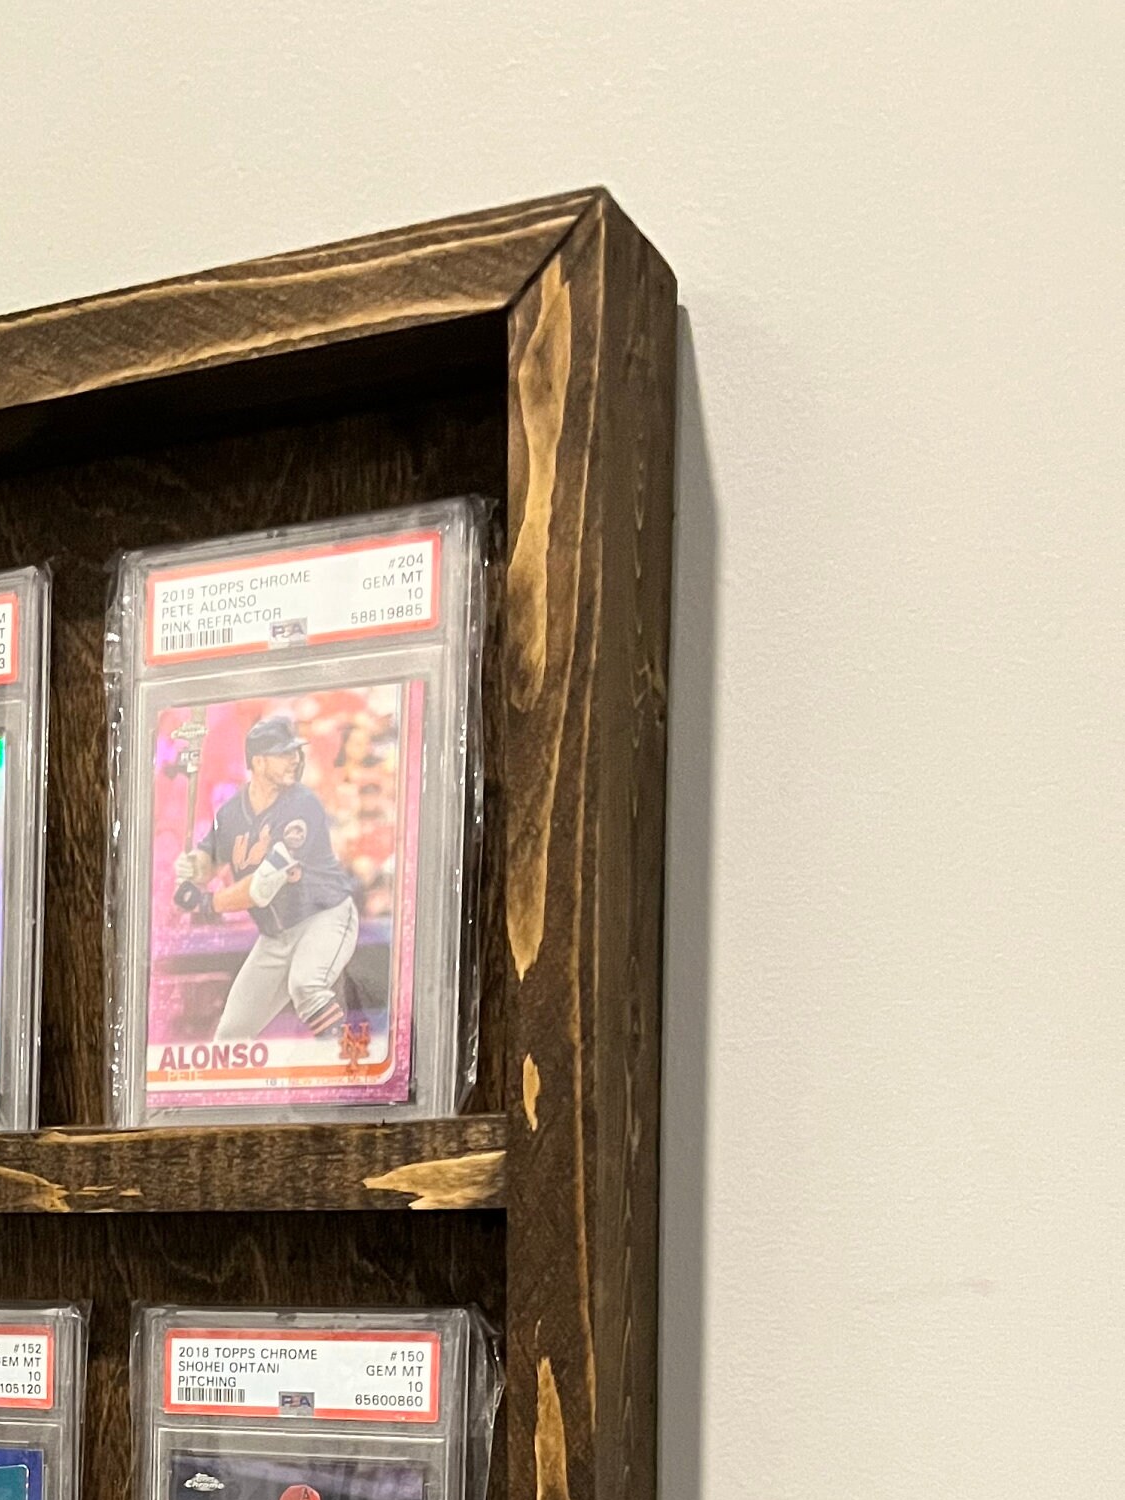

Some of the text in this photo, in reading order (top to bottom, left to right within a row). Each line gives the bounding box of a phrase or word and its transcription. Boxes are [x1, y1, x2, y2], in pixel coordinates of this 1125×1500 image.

[388, 553, 424, 570] #204
[162, 570, 310, 604] 2019 TOPPS CHROME
[363, 570, 423, 591] GEM MT
[408, 587, 423, 601] 10
[162, 595, 257, 619] PETE ALONSO
[162, 608, 282, 635] PINK REFRACTOR
[159, 1042, 269, 1070] ALONSO
[167, 1070, 204, 1082] PETE
[13, 1343, 42, 1354] #152
[179, 1346, 317, 1360] 2018 TOPPS CHROME
[24, 1357, 41, 1367] MT
[390, 1350, 424, 1363] #150
[179, 1360, 280, 1374] SHOHEI OHTANI
[366, 1365, 423, 1377] GEM MT
[28, 1371, 41, 1381] 10
[179, 1376, 236, 1388] PITCHING
[408, 1381, 423, 1393] 10
[355, 1394, 423, 1407] 65600860
